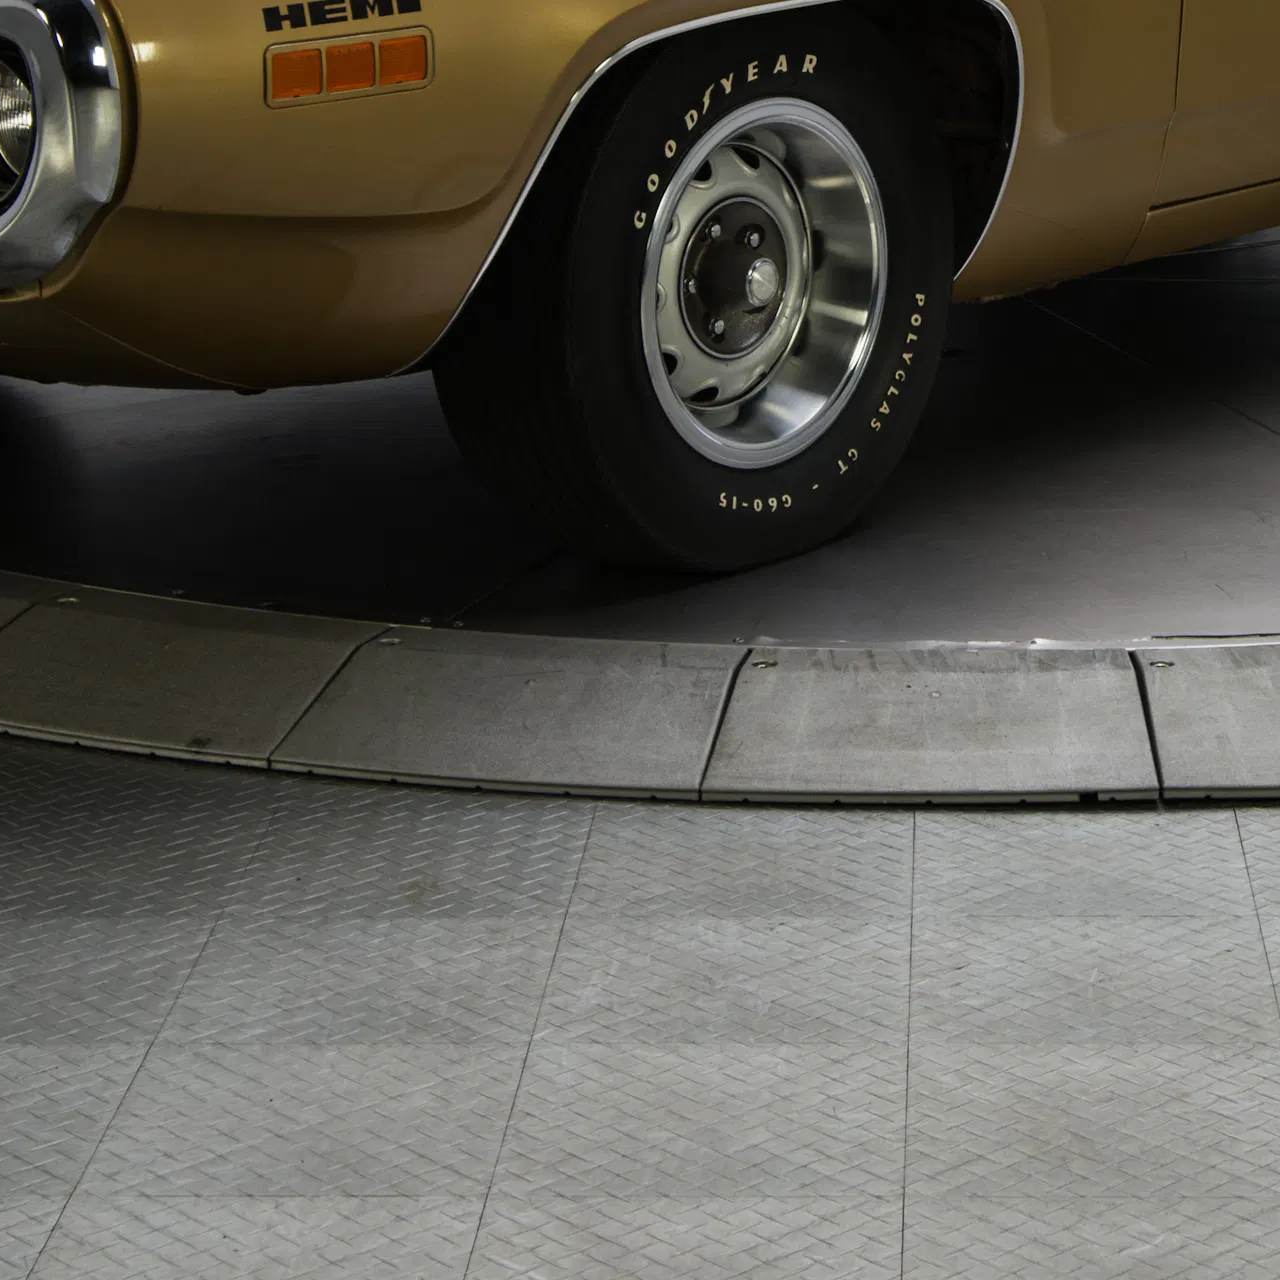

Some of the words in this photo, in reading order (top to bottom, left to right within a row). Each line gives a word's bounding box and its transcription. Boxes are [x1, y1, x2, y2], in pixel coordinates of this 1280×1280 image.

[634, 54, 818, 229] GOODYEAR
[870, 293, 926, 432] POLYGLAS
[719, 492, 792, 512] G60-15
[838, 448, 859, 475] GT
